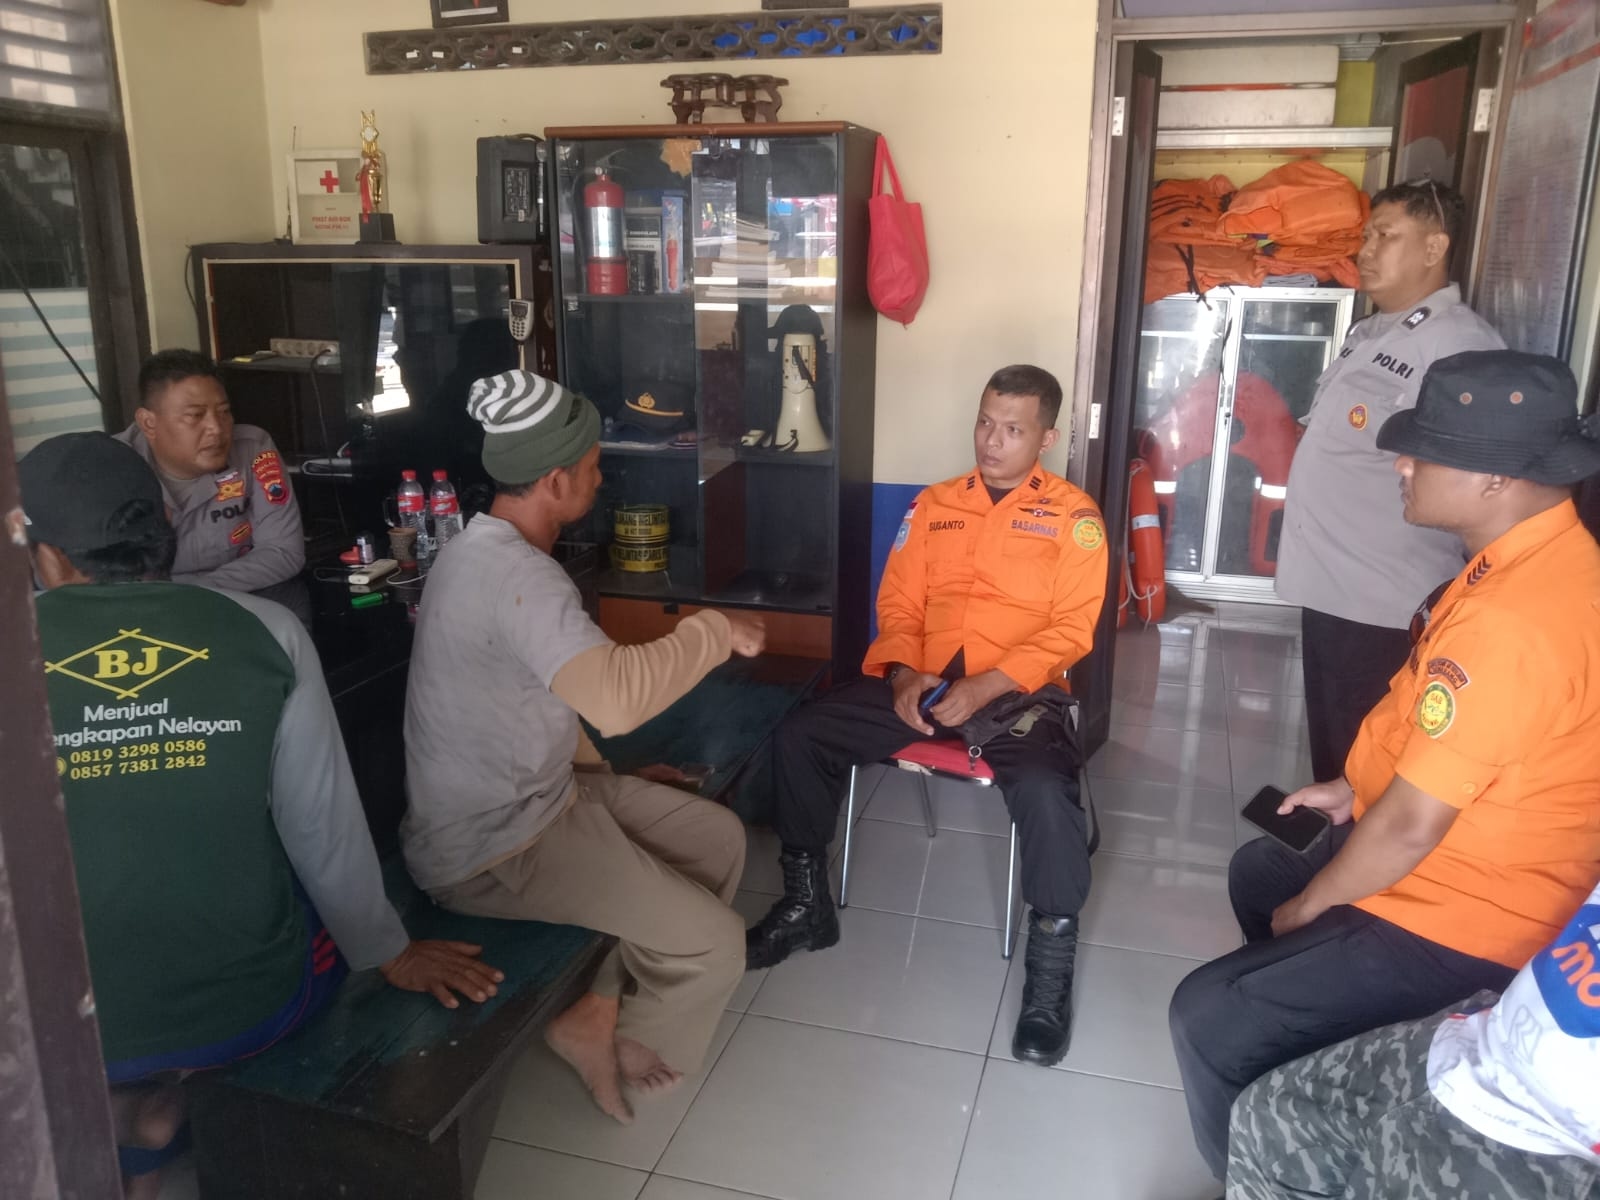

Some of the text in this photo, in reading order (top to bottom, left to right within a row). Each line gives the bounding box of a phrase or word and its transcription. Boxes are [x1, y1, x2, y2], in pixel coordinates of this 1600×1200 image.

[1372, 352, 1414, 379] POLRI
[1011, 519, 1058, 538] BASARNAS
[94, 646, 162, 679] BJ
[83, 697, 169, 722] Menjual
[158, 716, 242, 736] Nelayan
[70, 738, 206, 764] 0819 3298 0586
[70, 754, 206, 780] 0857 7381 2842
